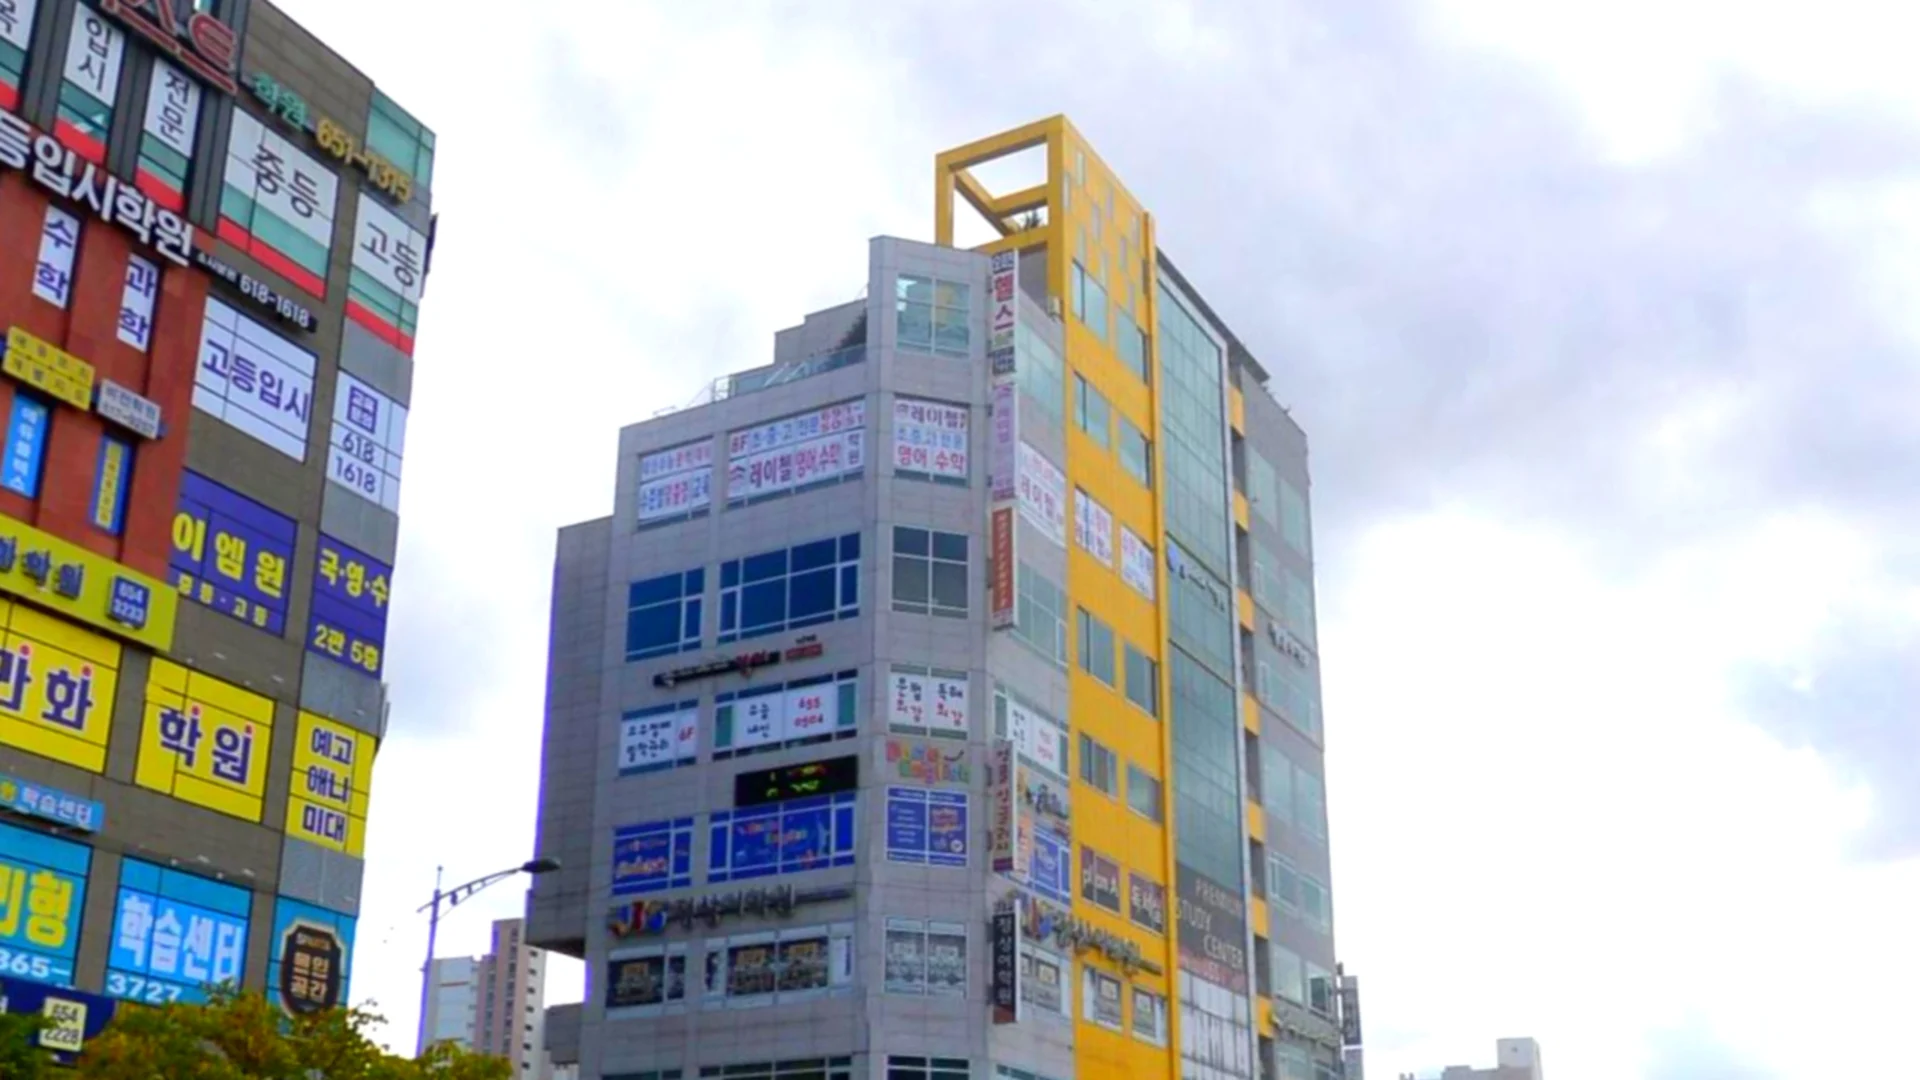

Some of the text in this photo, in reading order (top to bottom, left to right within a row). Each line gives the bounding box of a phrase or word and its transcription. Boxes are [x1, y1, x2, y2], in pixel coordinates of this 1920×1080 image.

[78, 17, 112, 91] 입시
[158, 67, 190, 145] 전문
[252, 144, 319, 219] 중등
[37, 220, 73, 300] 수학
[360, 221, 420, 287] 고등
[119, 262, 155, 343] 과학
[240, 273, 310, 328] 618-1618
[202, 339, 311, 423] 고등입시
[335, 456, 376, 494] 1618
[342, 433, 374, 463] 618
[171, 512, 286, 598] 이엠원
[159, 705, 253, 784] 학원
[311, 727, 353, 764] 예고
[22, 785, 93, 823] 학습센터
[306, 765, 349, 803] 애니
[302, 803, 346, 842] 미대
[119, 895, 243, 985] 학습센터
[108, 974, 183, 1003] 3727
